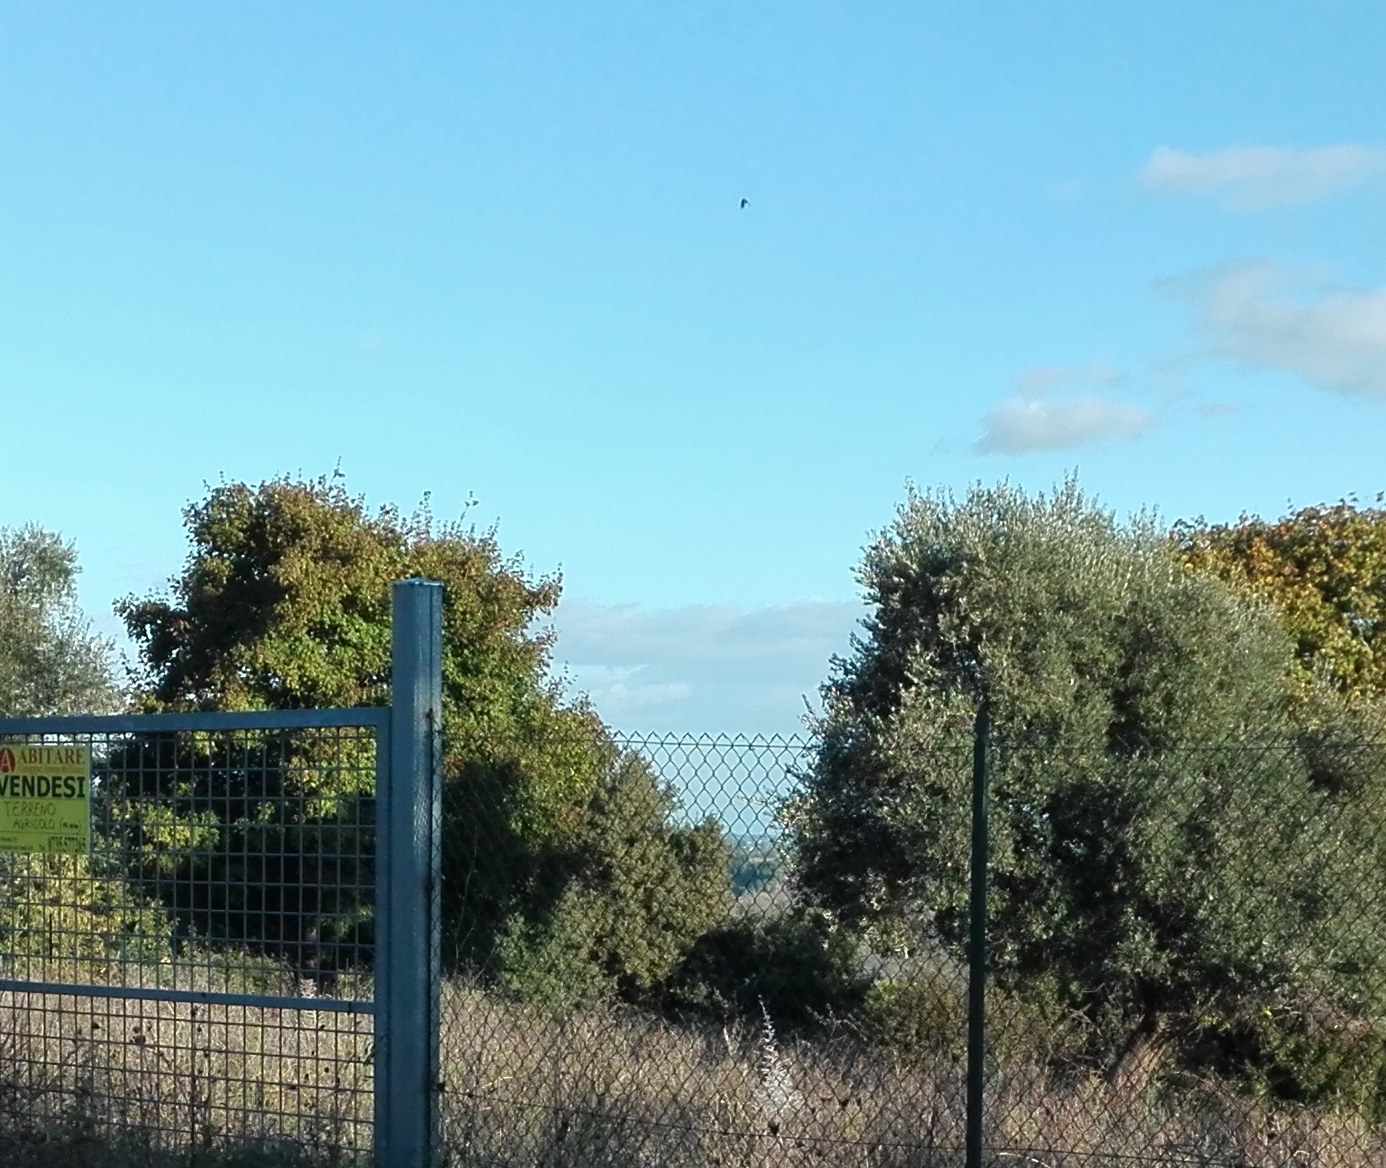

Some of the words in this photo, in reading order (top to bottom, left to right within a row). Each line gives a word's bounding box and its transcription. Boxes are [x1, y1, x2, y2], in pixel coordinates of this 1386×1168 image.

[18, 748, 86, 764] ABITARE
[4, 801, 56, 817] TERRENO
[13, 818, 55, 830] AGRICOLO
